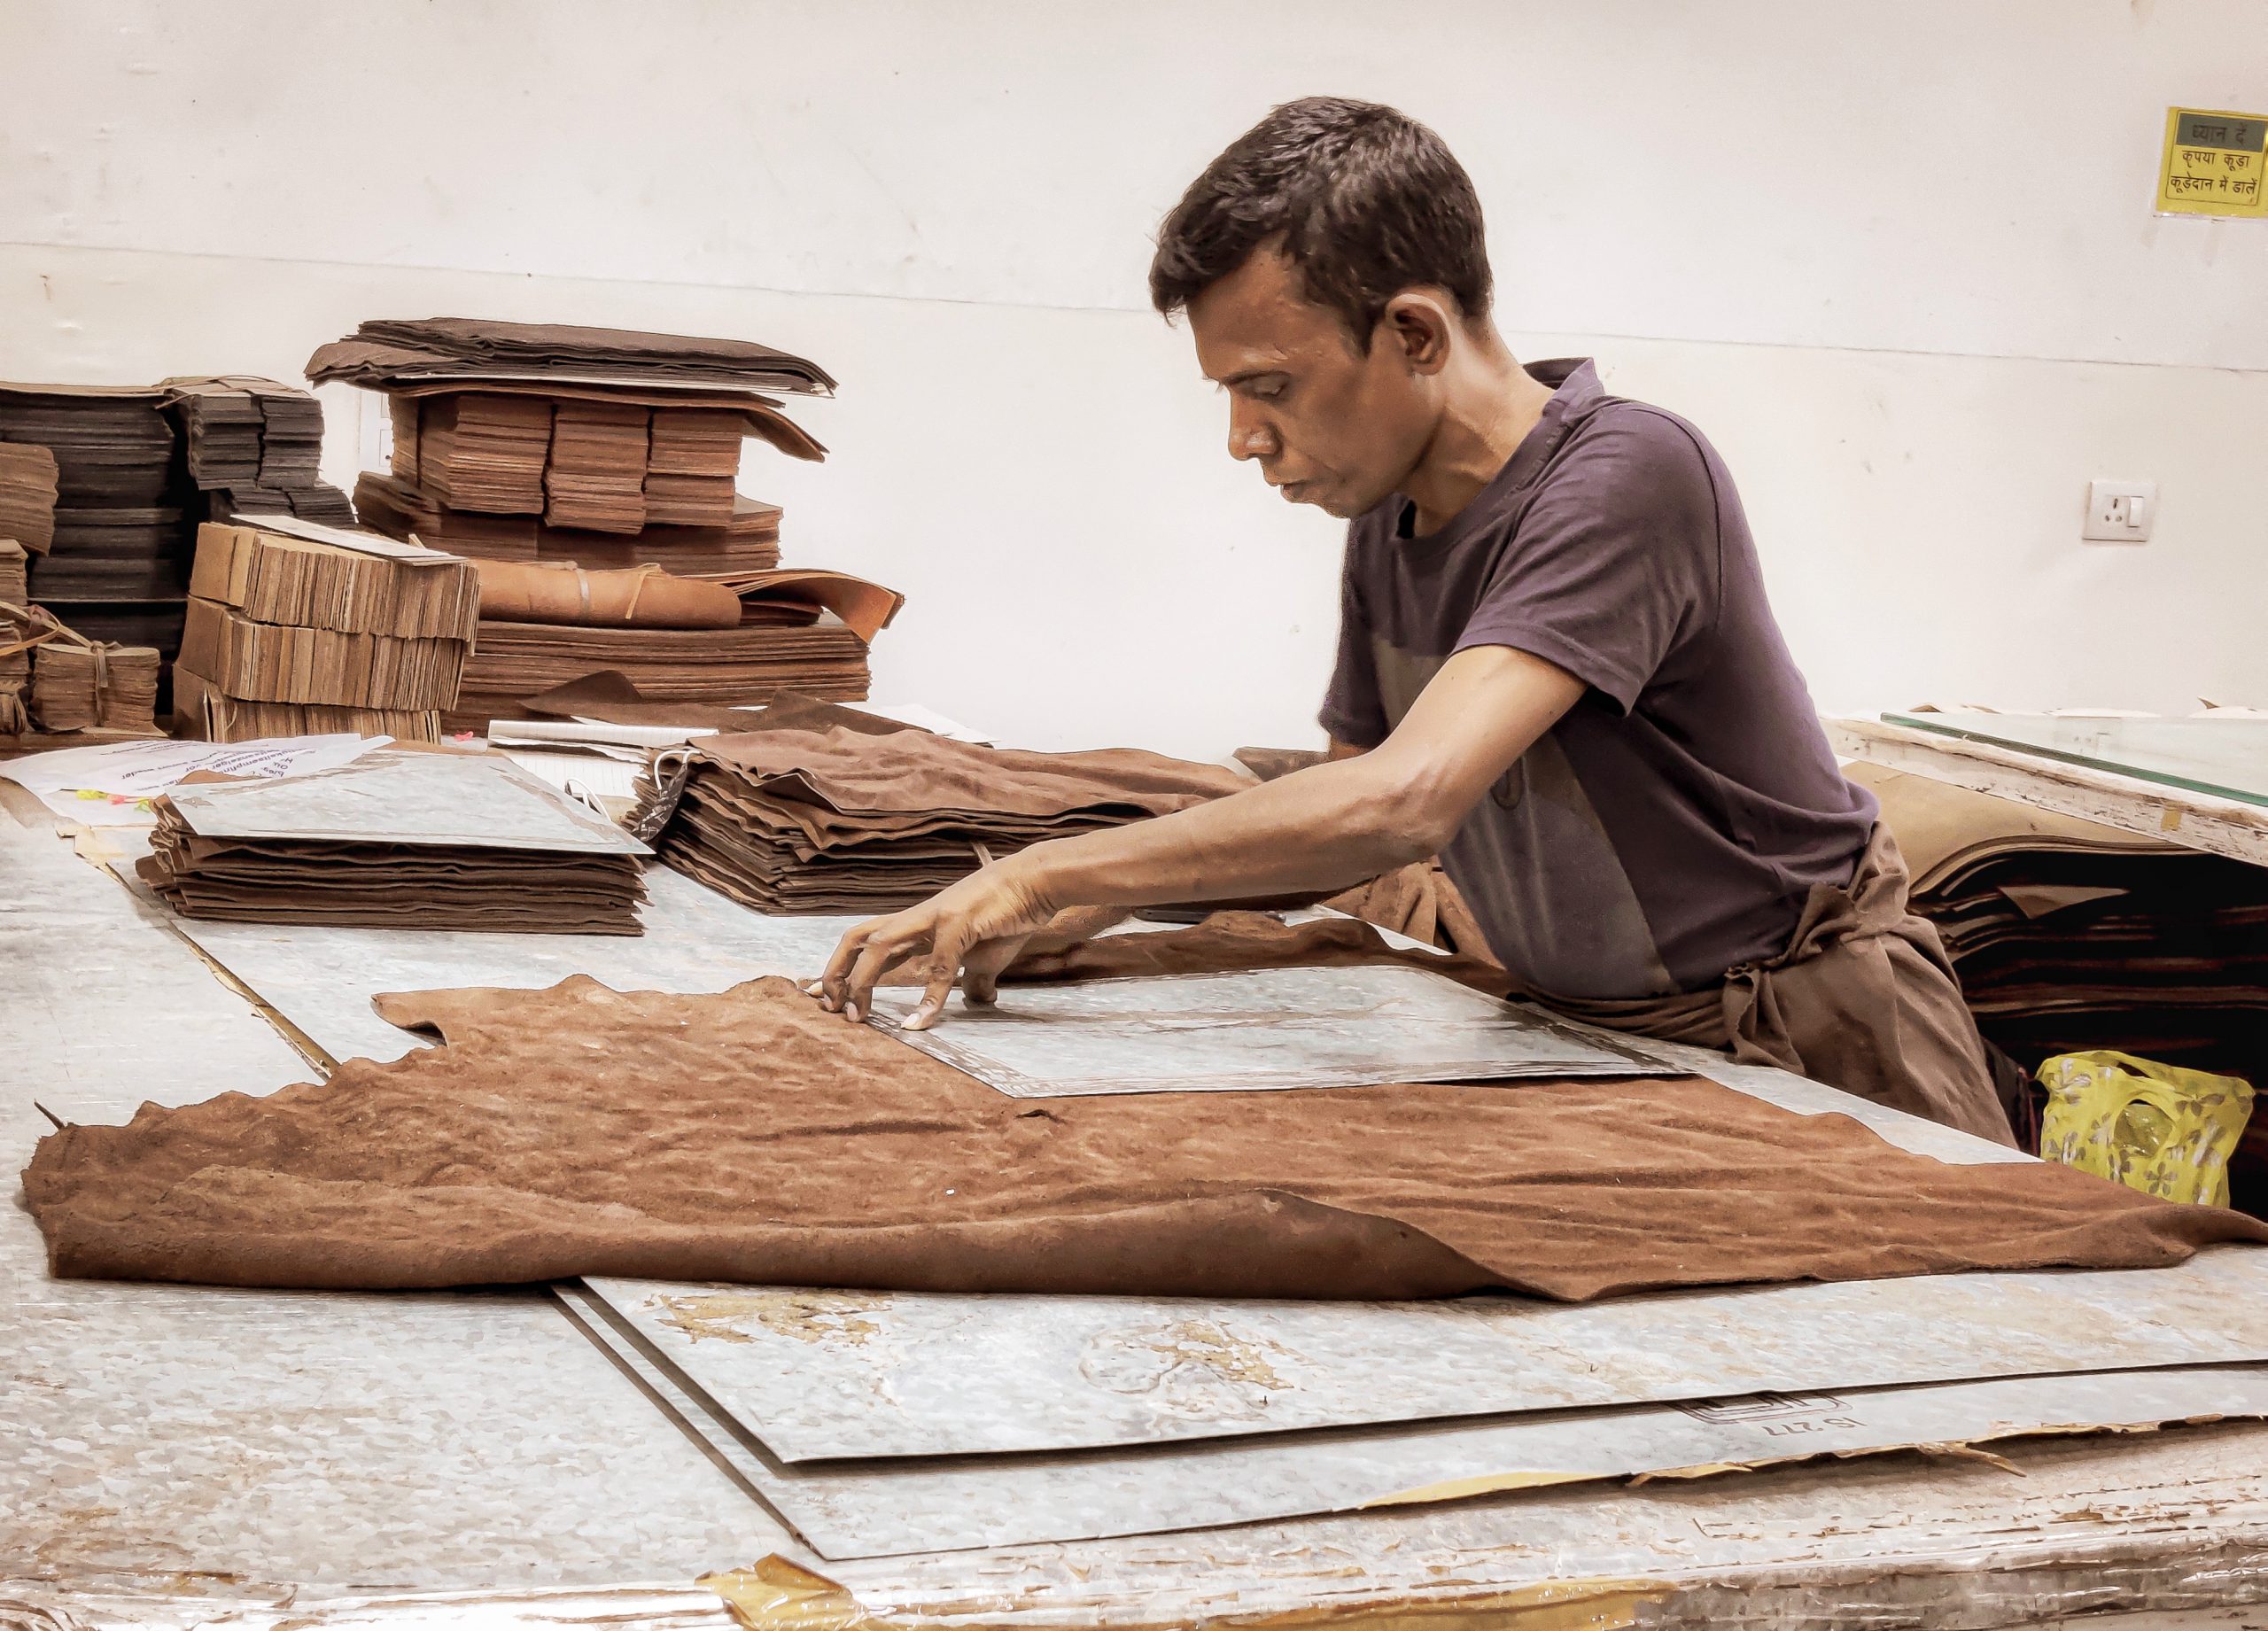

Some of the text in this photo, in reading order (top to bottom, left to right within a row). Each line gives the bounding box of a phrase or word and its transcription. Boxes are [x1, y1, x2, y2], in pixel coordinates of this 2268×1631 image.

[2192, 122, 2249, 144] ध्यान दें
[2182, 150, 2216, 168] कृपया
[2219, 175, 2229, 192] में
[2233, 178, 2257, 196] डालें
